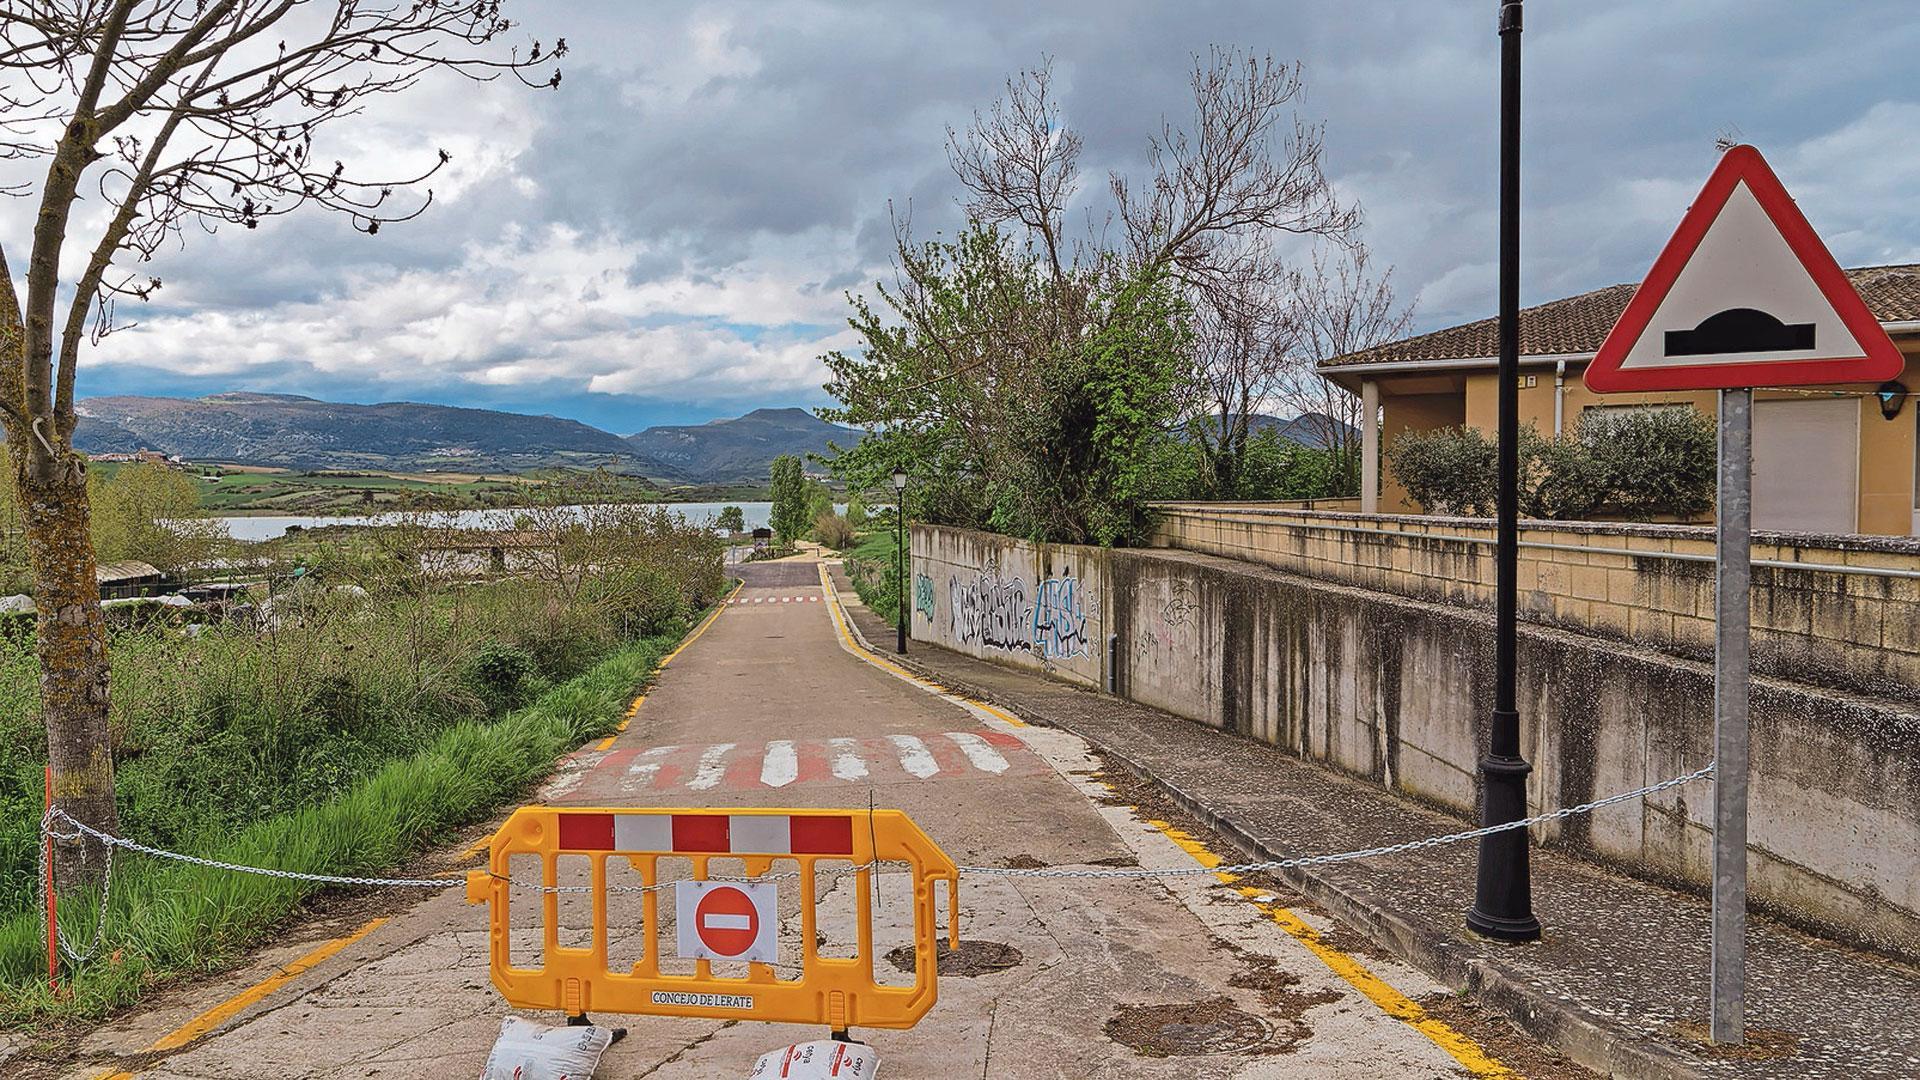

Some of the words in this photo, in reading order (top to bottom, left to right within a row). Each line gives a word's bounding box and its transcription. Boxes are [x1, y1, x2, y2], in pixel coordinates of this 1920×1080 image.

[653, 992, 698, 1005] CONCEJO
[700, 995, 714, 1006] DE
[715, 996, 752, 1008] LERATE
